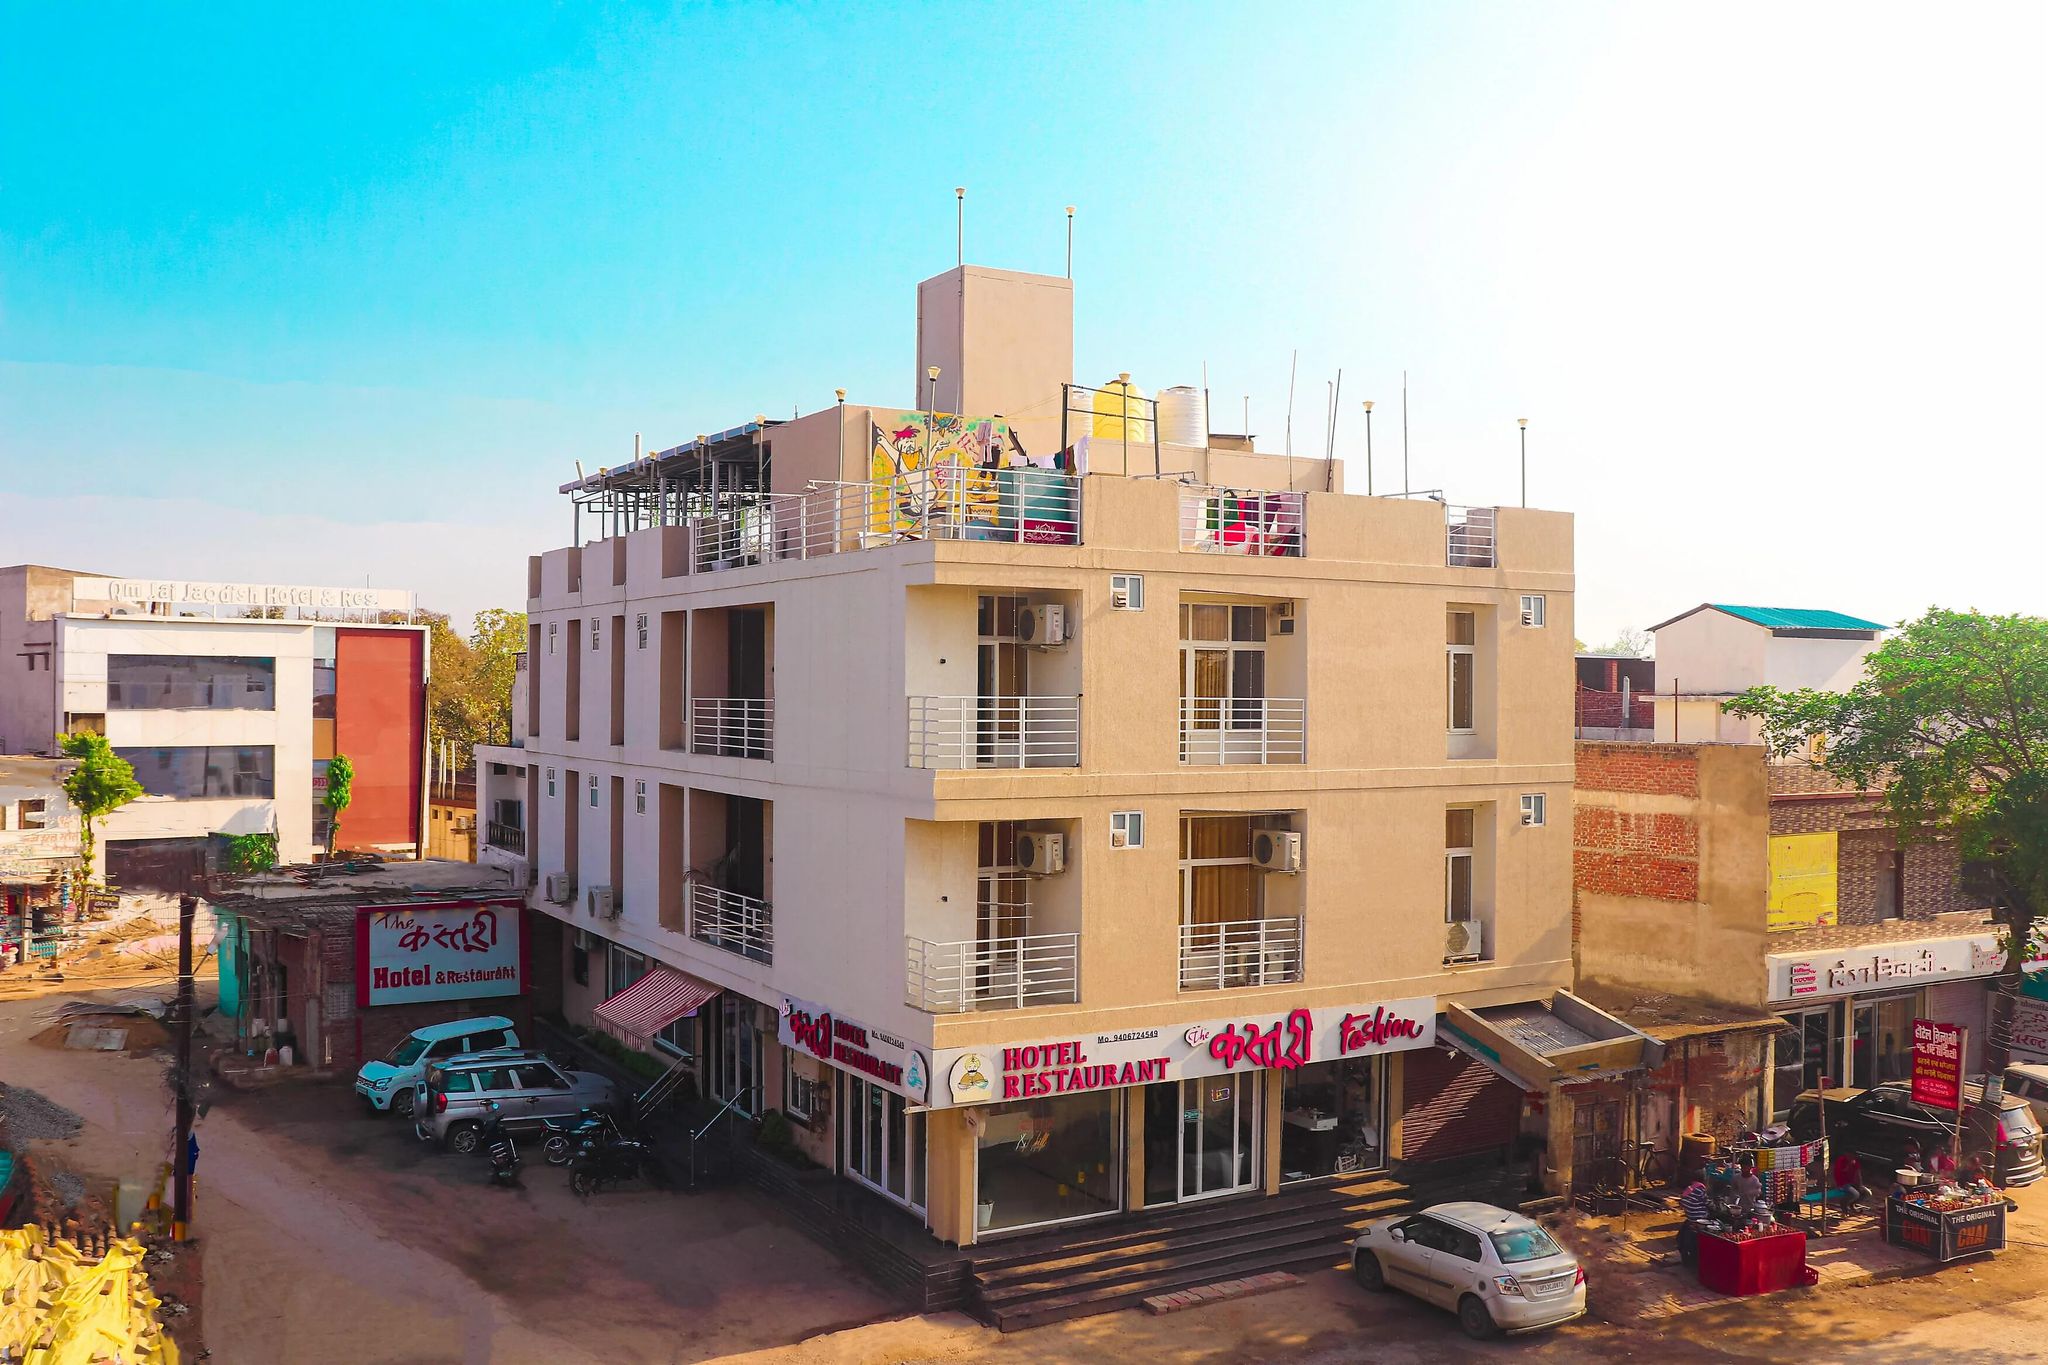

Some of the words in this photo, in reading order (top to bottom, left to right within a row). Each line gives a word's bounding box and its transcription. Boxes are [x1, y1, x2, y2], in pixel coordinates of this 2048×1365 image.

[149, 581, 176, 600] Jai
[266, 586, 314, 605] Hotel
[341, 589, 378, 607] Res.
[375, 913, 415, 929] The
[373, 964, 431, 989] Hotel
[1098, 1034, 1112, 1044] Mo.
[1114, 1029, 1159, 1041] 9406724549
[1188, 1028, 1210, 1044] The
[1339, 1005, 1424, 1056] Fashion
[1003, 1040, 1088, 1072] HOTEL
[1003, 1056, 1171, 1099] RESTAURANT
[1909, 1208, 1940, 1225] ORIGINAL
[1951, 1215, 1966, 1225] THE
[1966, 1209, 1997, 1222] ORIGINAL
[1958, 1223, 1988, 1247] CHAI
